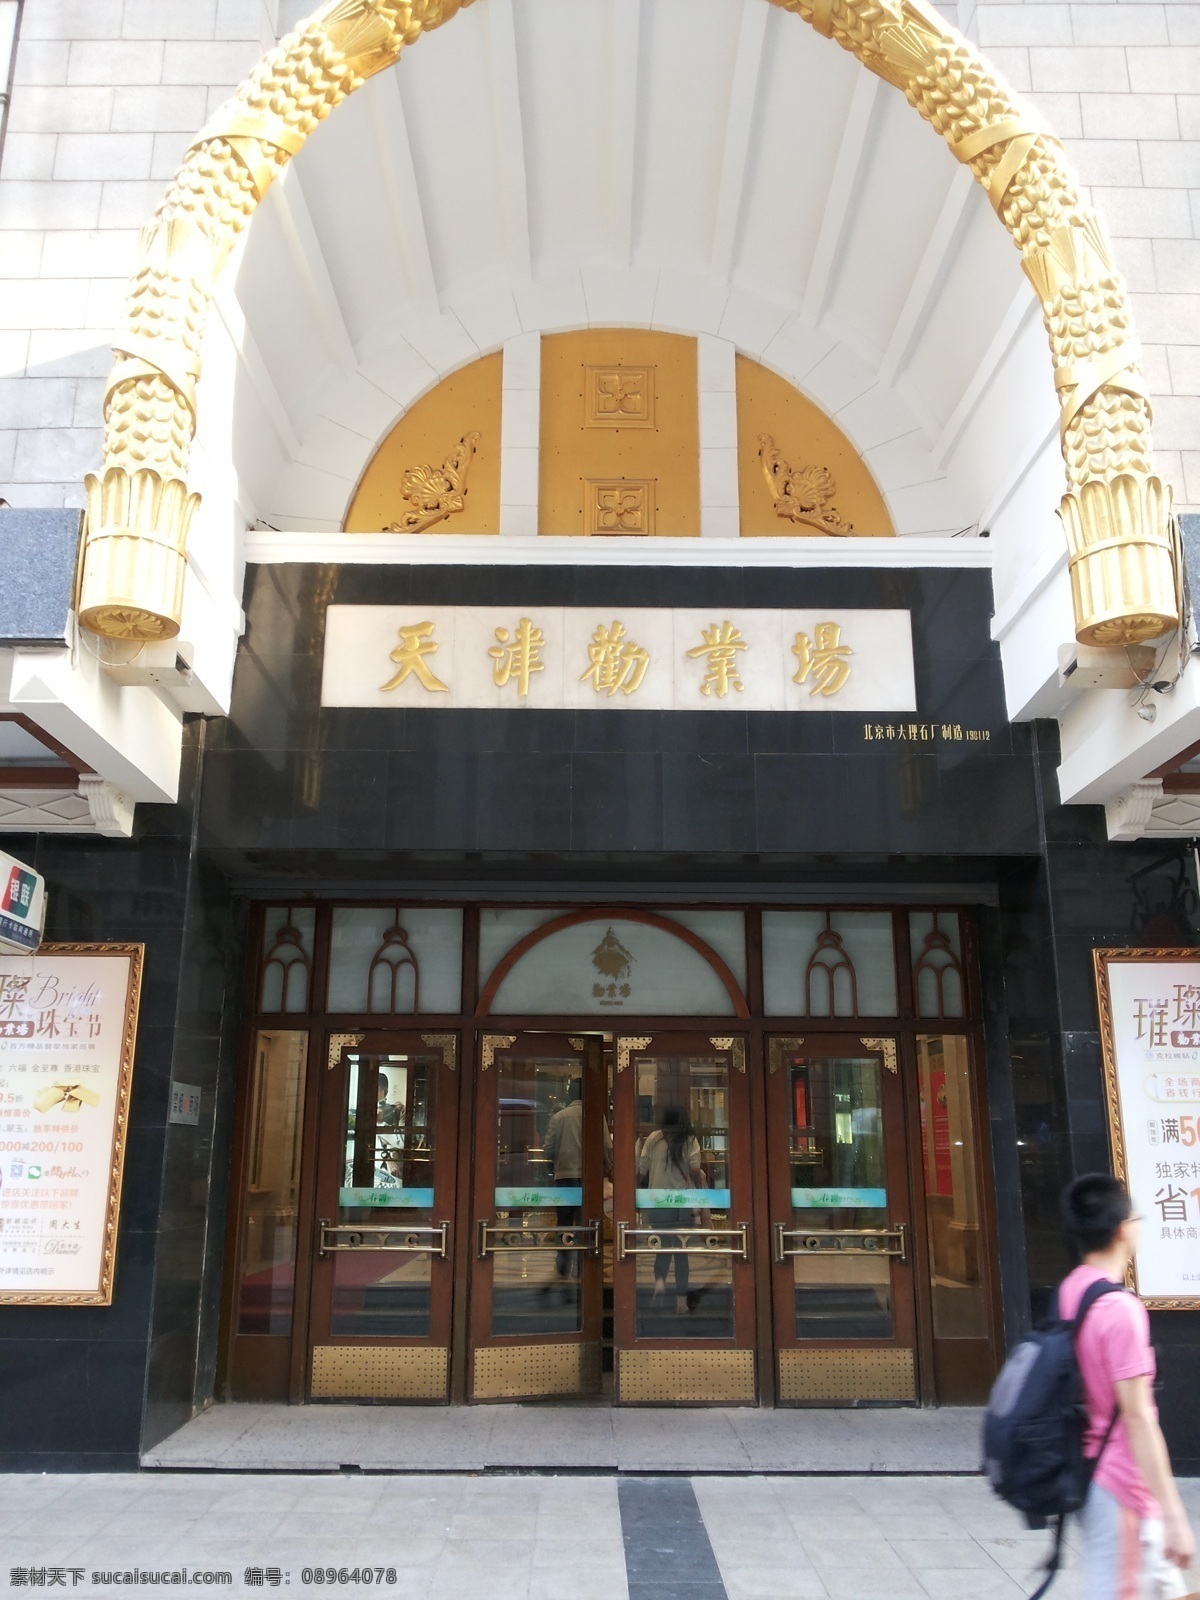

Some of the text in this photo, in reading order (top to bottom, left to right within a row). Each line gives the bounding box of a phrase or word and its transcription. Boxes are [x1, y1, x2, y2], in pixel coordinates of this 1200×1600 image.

[380, 616, 853, 697] 天津勸業場
[863, 724, 963, 741] 北京市大理石厂制造
[29, 972, 102, 1013] Bright
[37, 1009, 102, 1039] 珠宝节
[64, 1064, 101, 1073] 香港珠宝
